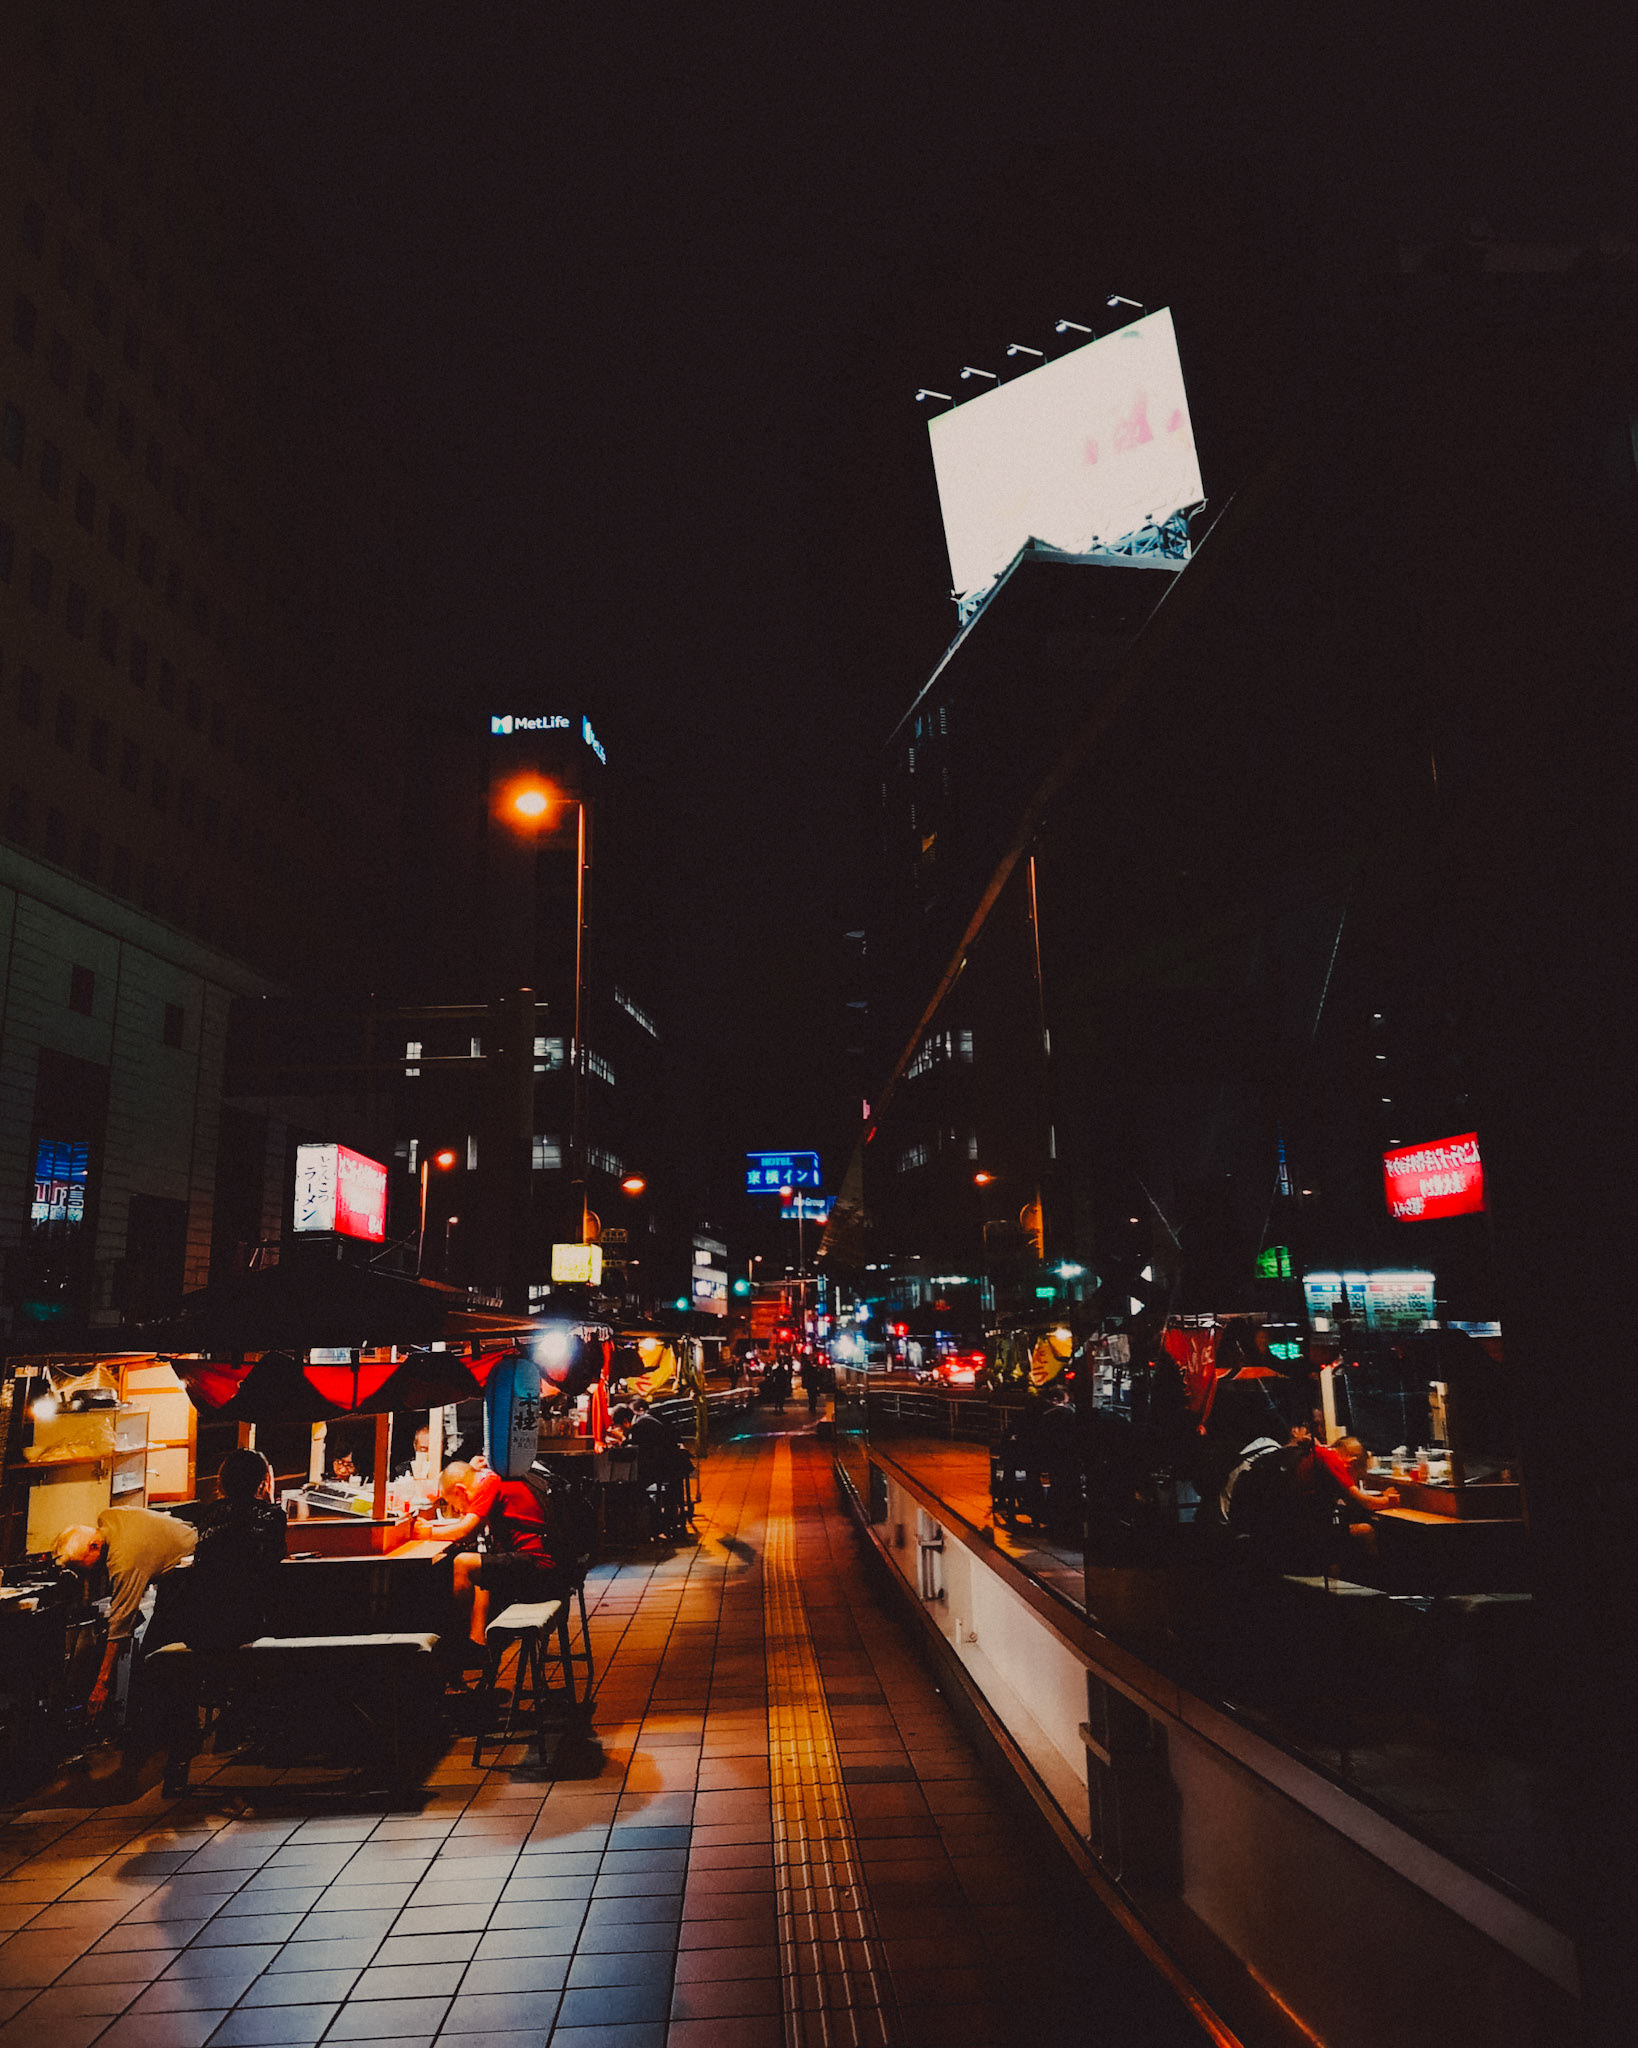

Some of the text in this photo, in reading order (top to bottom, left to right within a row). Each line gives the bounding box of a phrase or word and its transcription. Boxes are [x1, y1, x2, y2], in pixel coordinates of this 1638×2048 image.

[514, 715, 570, 730] MetLife
[761, 1157, 793, 1166] HOTEL
[317, 1155, 331, 1204] とんこつ
[746, 1169, 808, 1185] 東横イン
[301, 1166, 319, 1222] ラーメン
